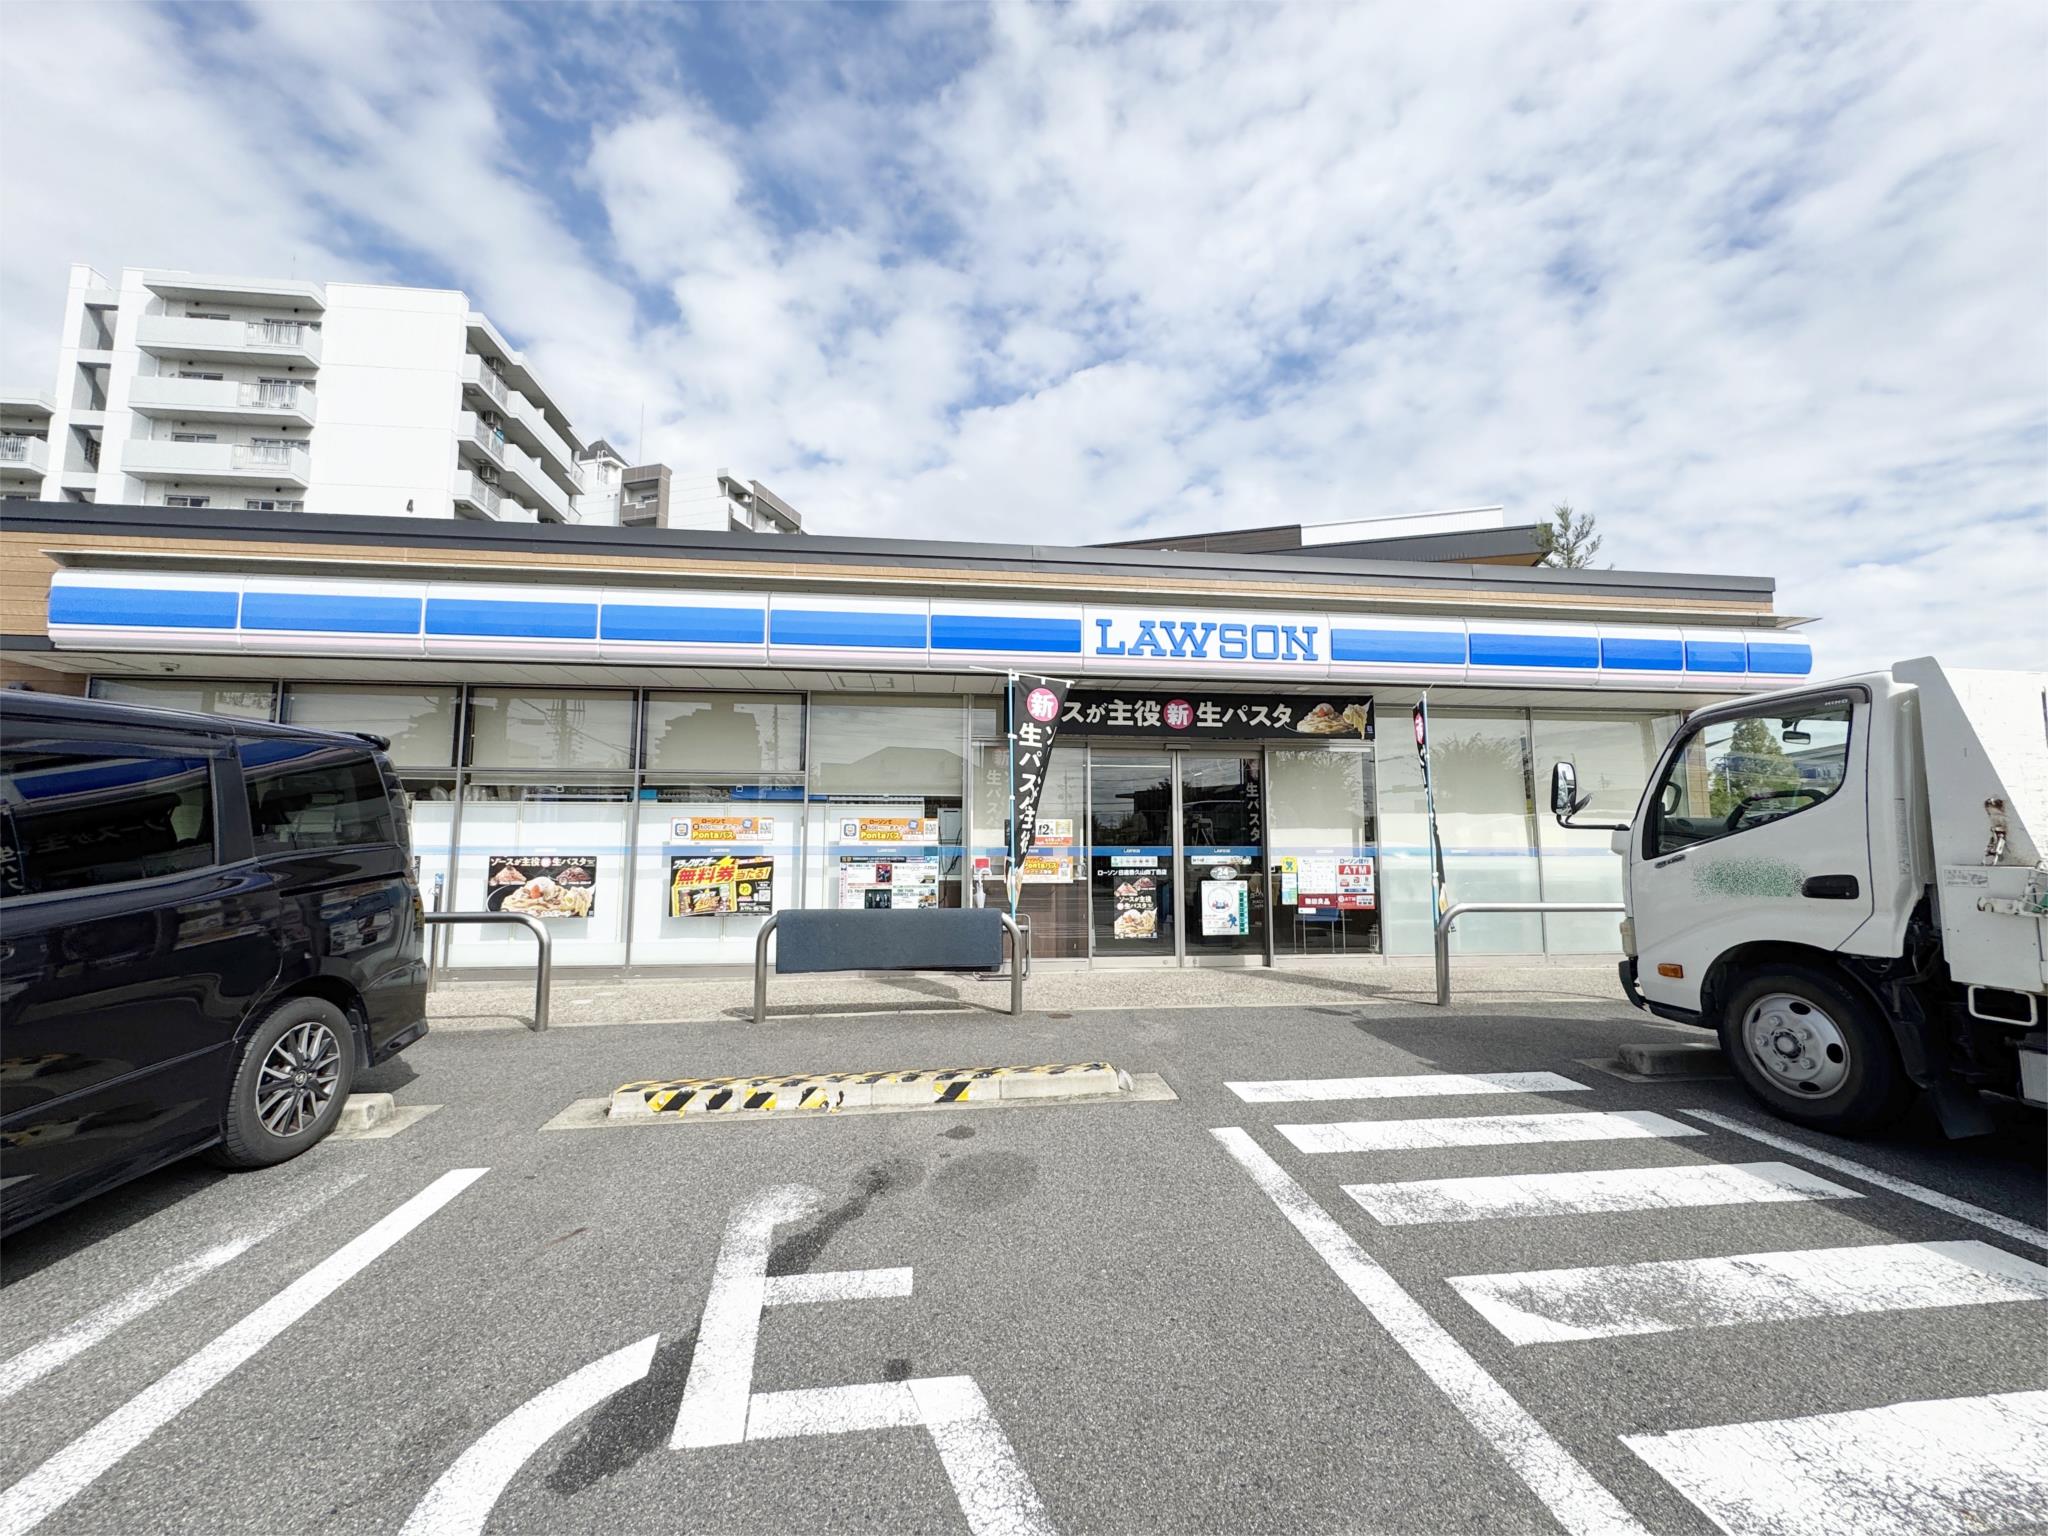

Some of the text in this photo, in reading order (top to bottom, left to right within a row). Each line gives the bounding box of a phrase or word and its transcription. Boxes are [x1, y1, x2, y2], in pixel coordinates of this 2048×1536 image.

[1095, 618, 1319, 661] LAWSON
[1031, 692, 1055, 718] 新
[1344, 865, 1367, 875] ATM
